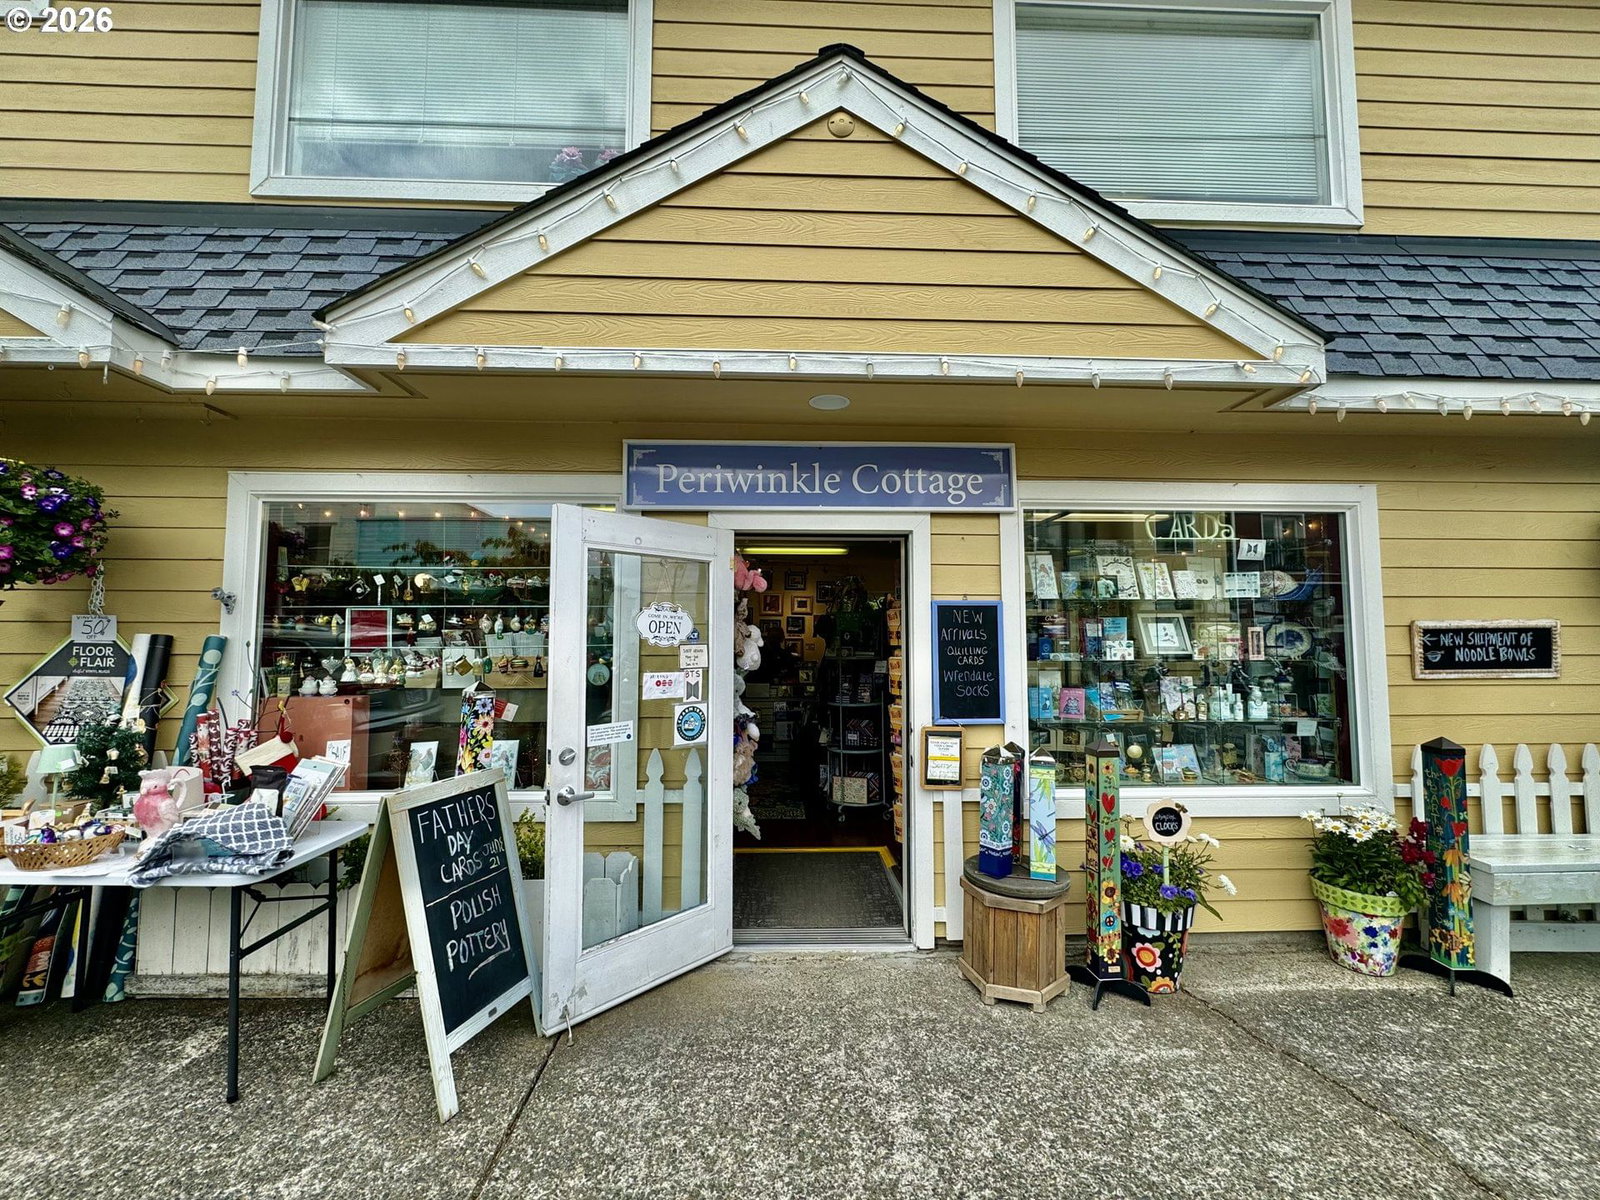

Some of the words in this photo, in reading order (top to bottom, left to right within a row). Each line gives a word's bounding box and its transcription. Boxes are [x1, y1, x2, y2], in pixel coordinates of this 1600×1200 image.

[655, 462, 841, 495] Periwinkle
[851, 463, 983, 505] Cottage
[1145, 512, 1236, 540] CARDS
[952, 609, 984, 625] NEW
[648, 619, 682, 635] OPEN
[1439, 632, 1464, 647] NEW
[1466, 631, 1518, 649] SHIPMENT
[1519, 631, 1534, 647] OF
[72, 646, 114, 657] FLOOR
[946, 645, 989, 657] QUILLING
[1454, 646, 1497, 663] NOODLE
[1499, 646, 1537, 663] BOWLS
[79, 657, 116, 668] FLAIR
[957, 655, 985, 666] CARDS
[684, 669, 701, 679] BTS
[943, 669, 995, 683] Wrendale
[955, 683, 990, 698] SOCKS
[417, 791, 496, 844] FATHERS
[1155, 821, 1179, 832] CLOCKS
[447, 829, 474, 857] DAY
[482, 837, 505, 857] JUNE
[440, 852, 483, 884] CARDS
[489, 858, 501, 870] 21
[450, 883, 502, 931] POLISH
[446, 918, 510, 973] POTTERY
